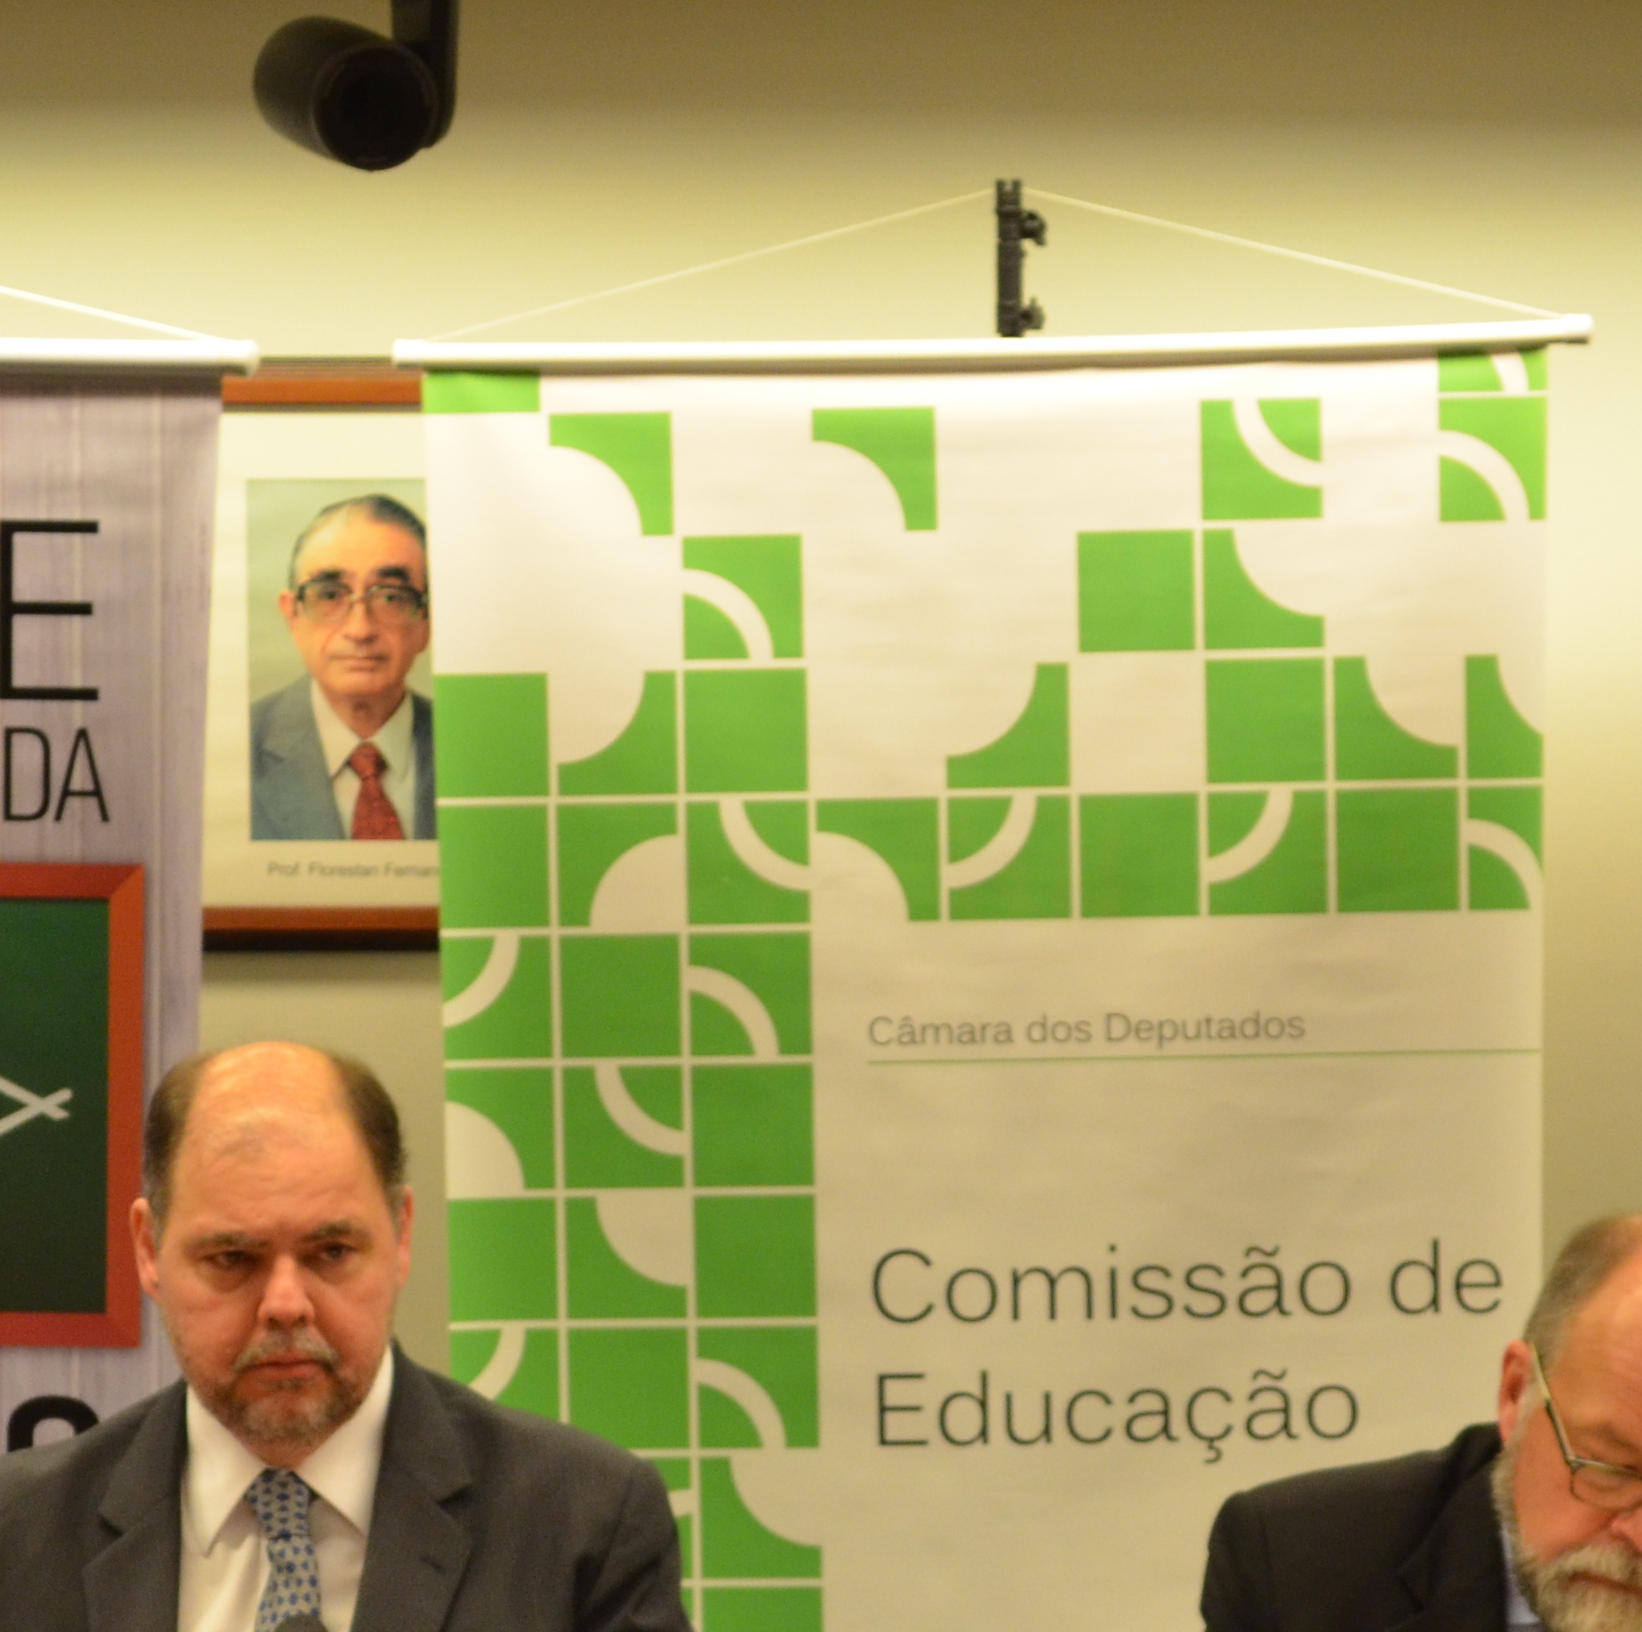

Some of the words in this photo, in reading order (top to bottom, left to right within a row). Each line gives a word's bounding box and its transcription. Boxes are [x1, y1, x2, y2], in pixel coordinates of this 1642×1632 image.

[2, 726, 111, 824] DA
[868, 1014, 1015, 1046] Câmara
[1025, 1013, 1093, 1044] dos
[1103, 1011, 1307, 1051] Deputados
[871, 1242, 1353, 1324] Comissão
[1388, 1237, 1504, 1316] de
[875, 1367, 1360, 1464] Educação
